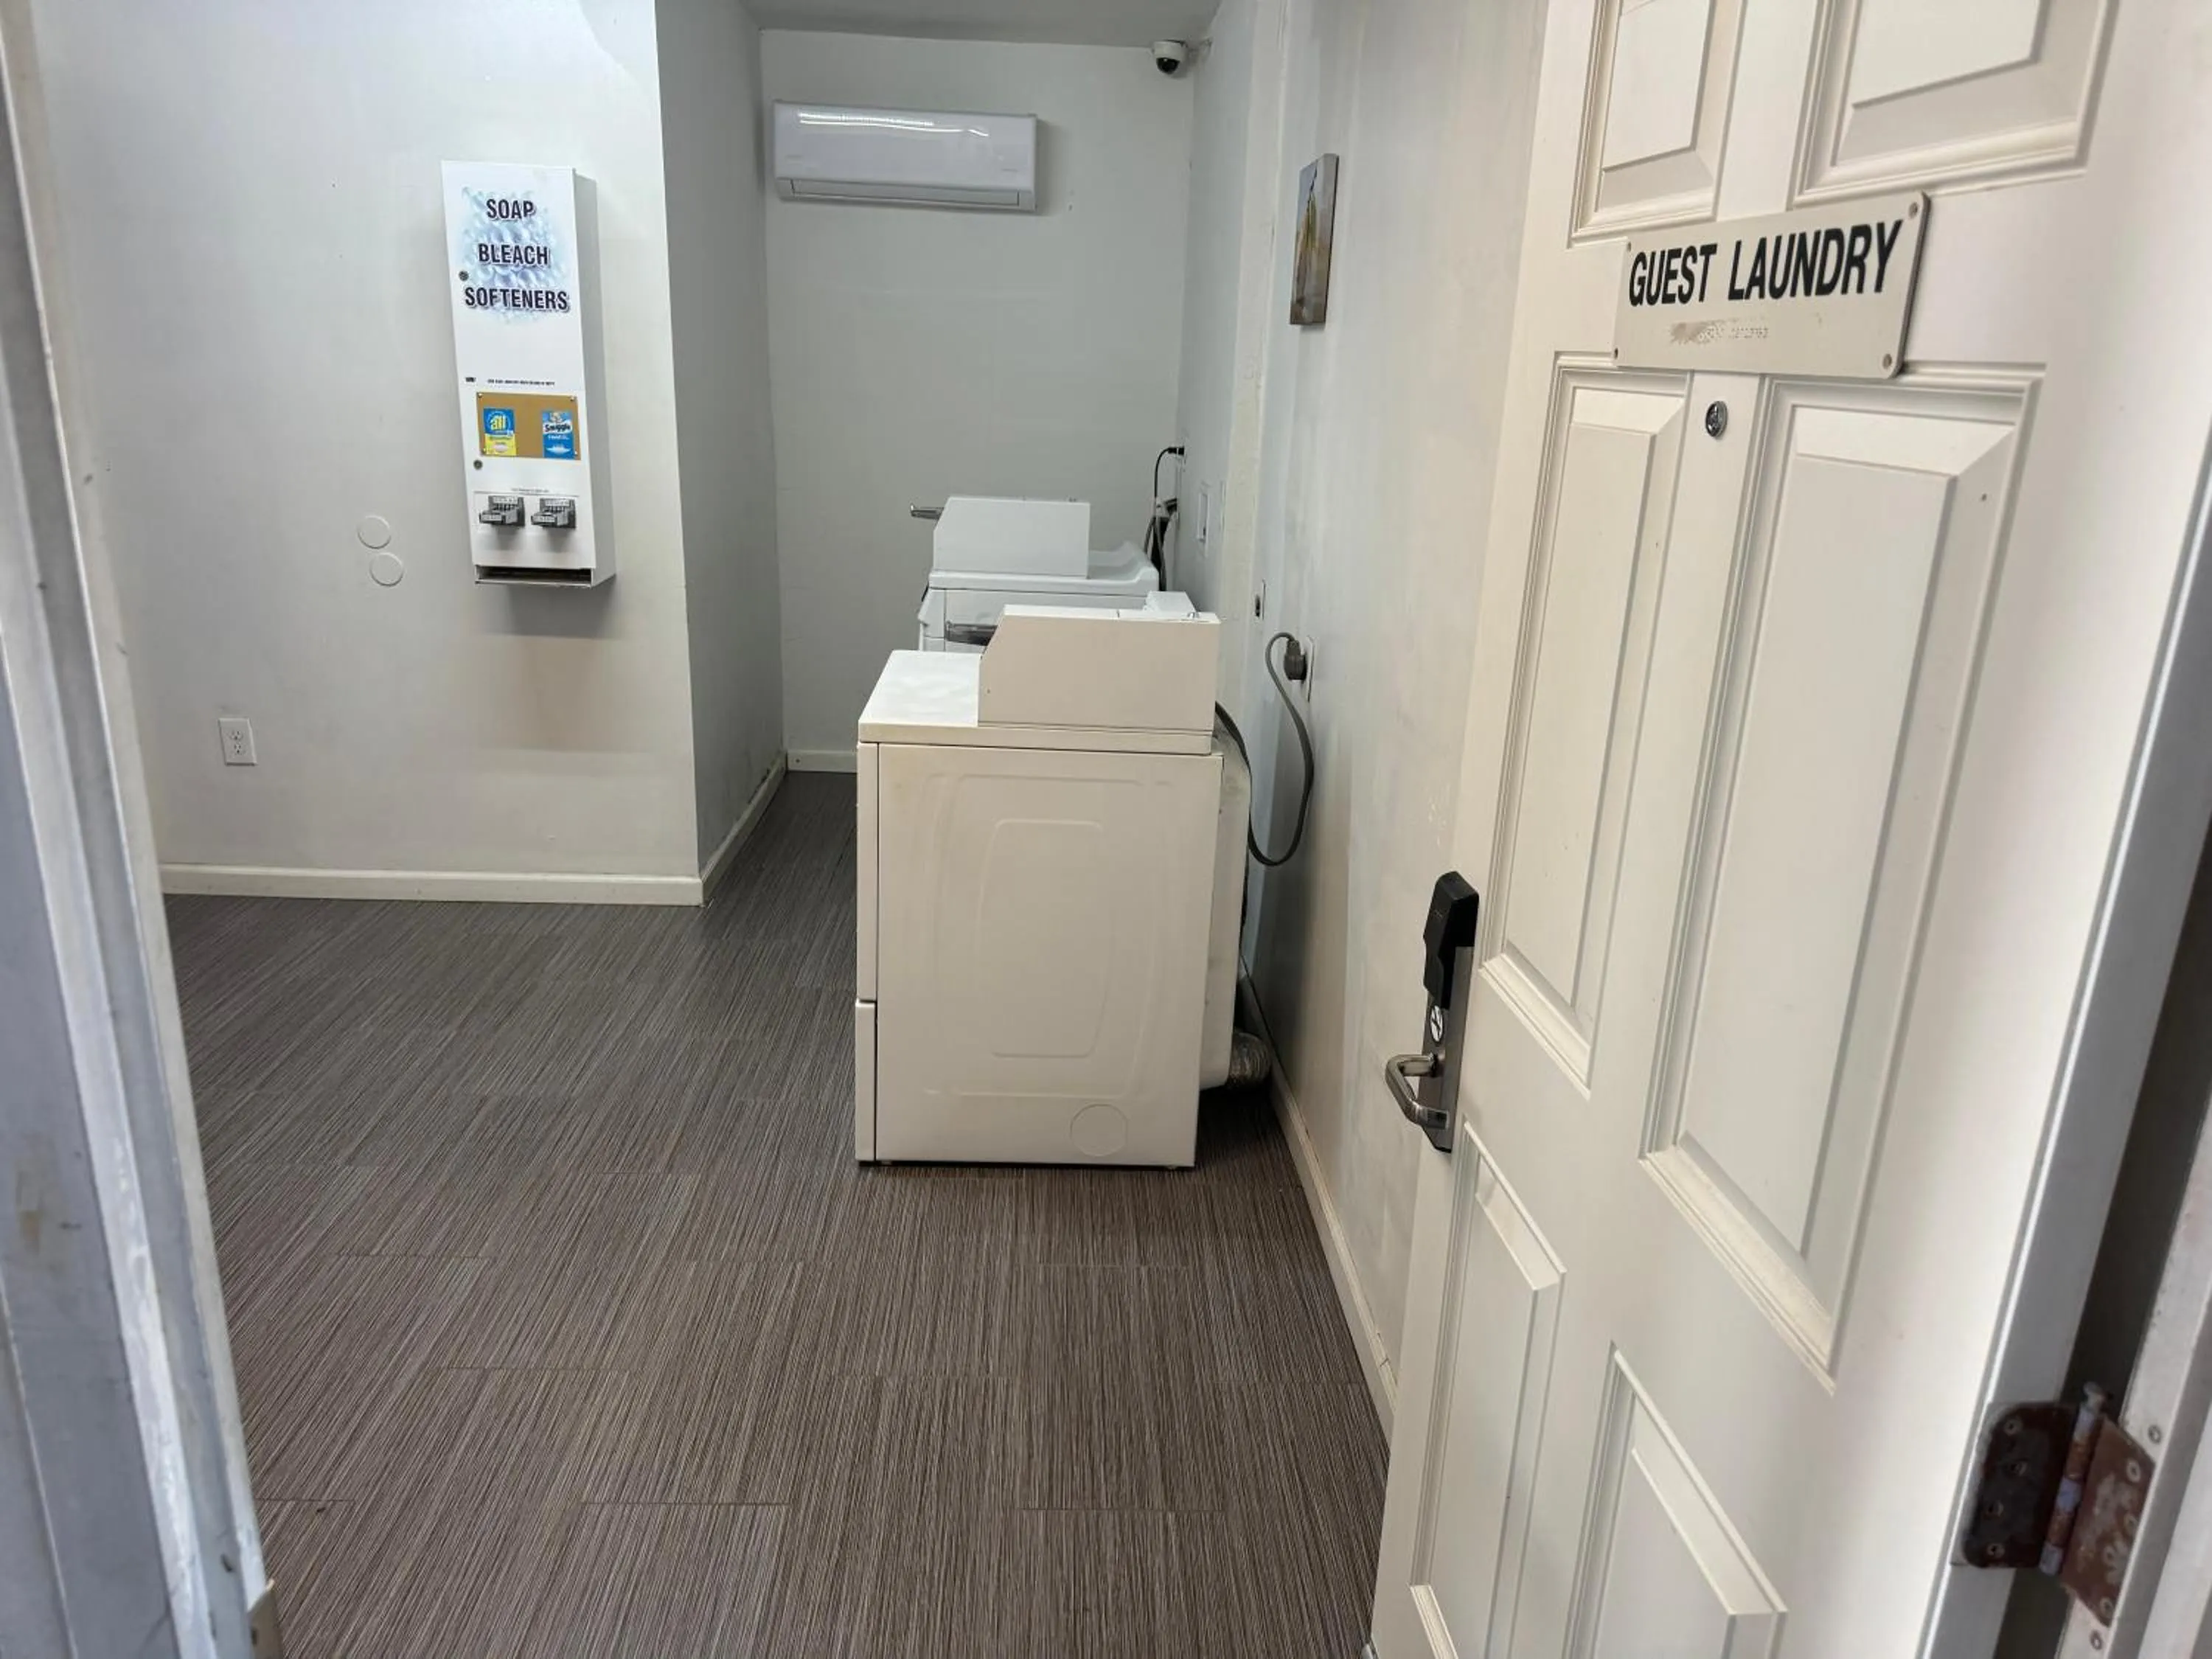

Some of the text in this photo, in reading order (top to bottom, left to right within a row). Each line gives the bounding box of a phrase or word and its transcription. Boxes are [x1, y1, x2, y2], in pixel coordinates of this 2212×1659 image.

[486, 198, 535, 219] SOAP
[478, 243, 549, 265] BLEACH
[1629, 220, 1903, 306] GUEST LAUNDRY
[465, 287, 568, 310] SOFTENERS
[490, 414, 507, 431] all
